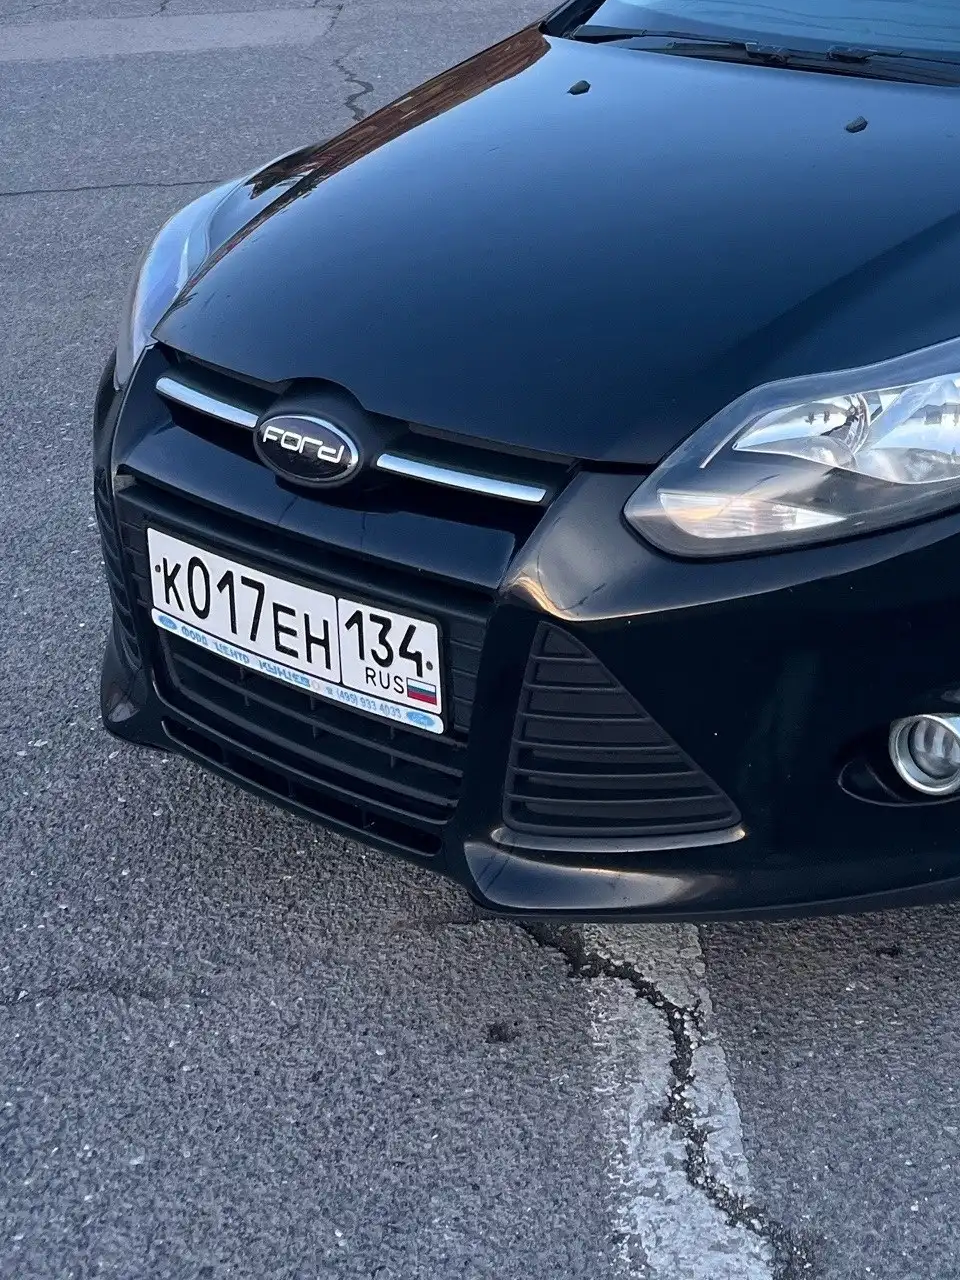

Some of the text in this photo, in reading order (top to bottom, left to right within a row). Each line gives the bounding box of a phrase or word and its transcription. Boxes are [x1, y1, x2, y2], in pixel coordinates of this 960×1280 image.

[345, 610, 424, 678] 134
[365, 666, 405, 695] RUS
[360, 696, 377, 712] 933
